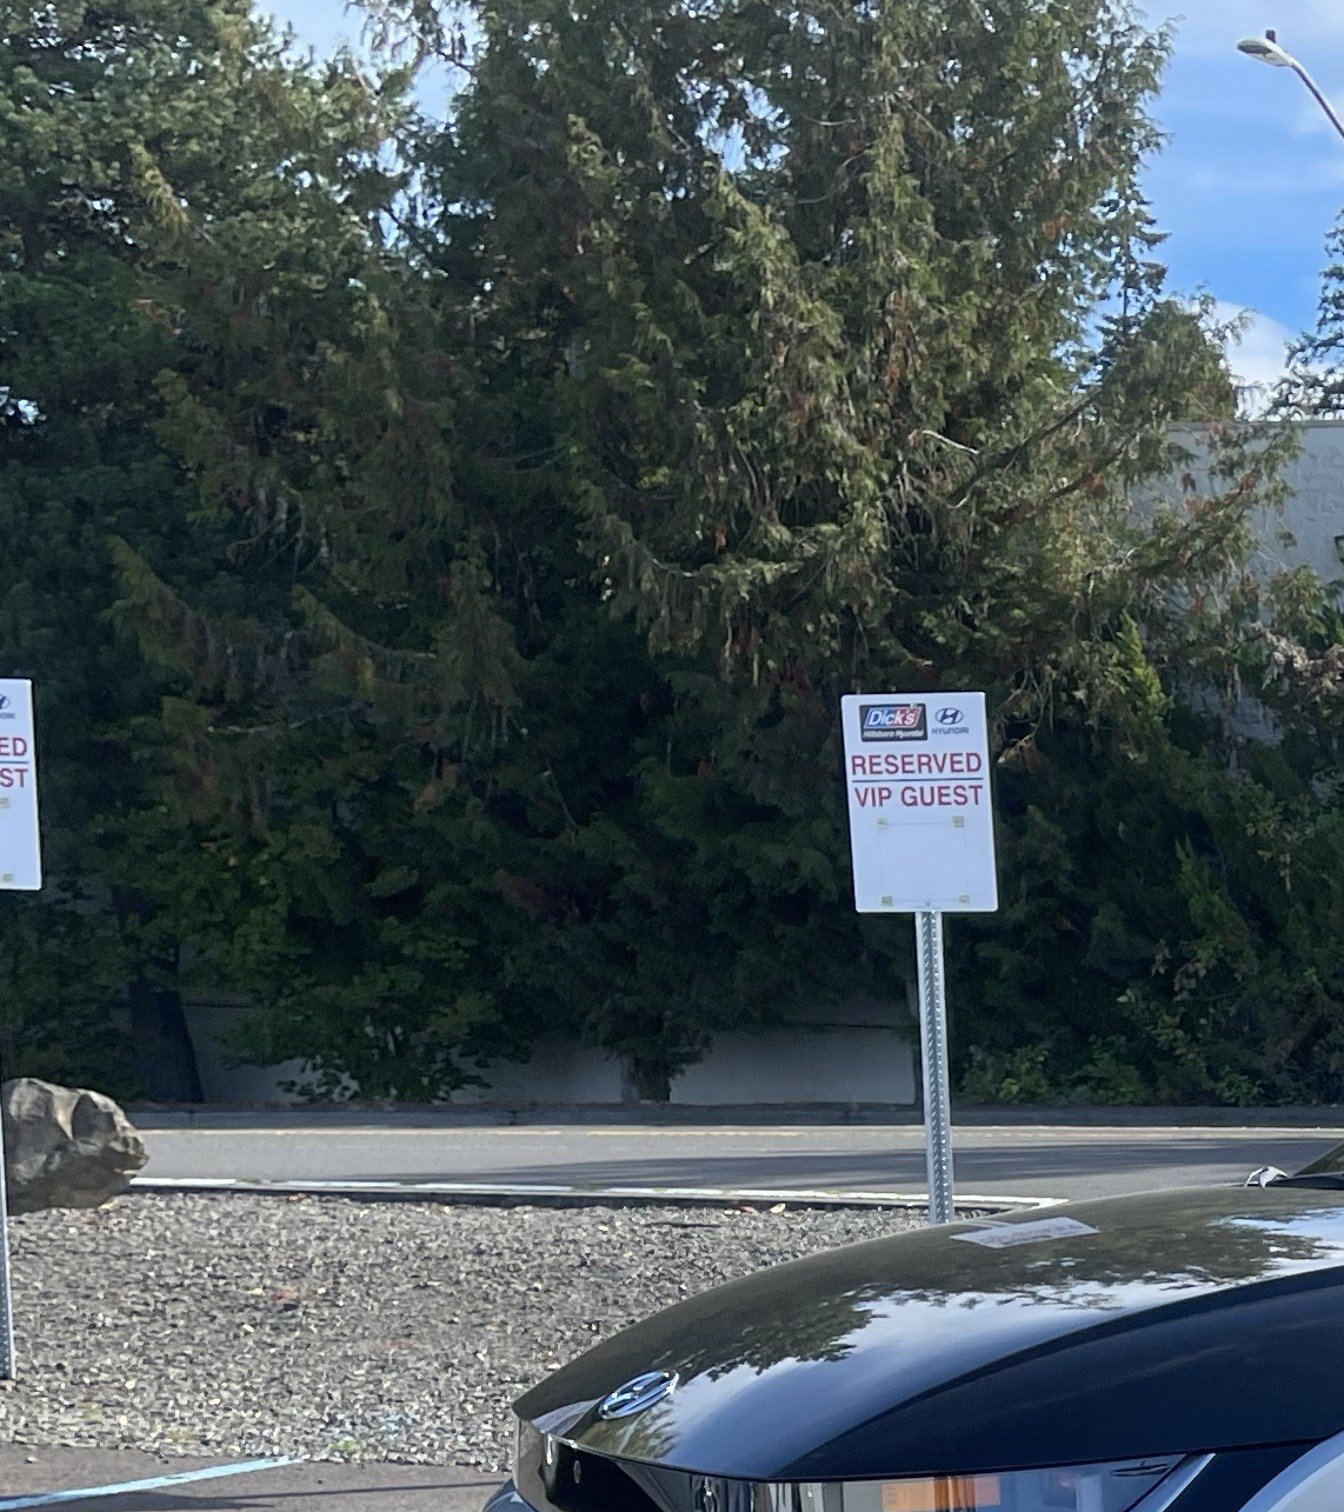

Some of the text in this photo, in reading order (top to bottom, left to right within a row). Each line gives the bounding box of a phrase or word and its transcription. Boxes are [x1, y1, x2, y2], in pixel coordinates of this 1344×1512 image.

[868, 707, 918, 726] Dick's
[851, 752, 983, 776] RESERVED
[854, 784, 984, 808] VIP GUEST
